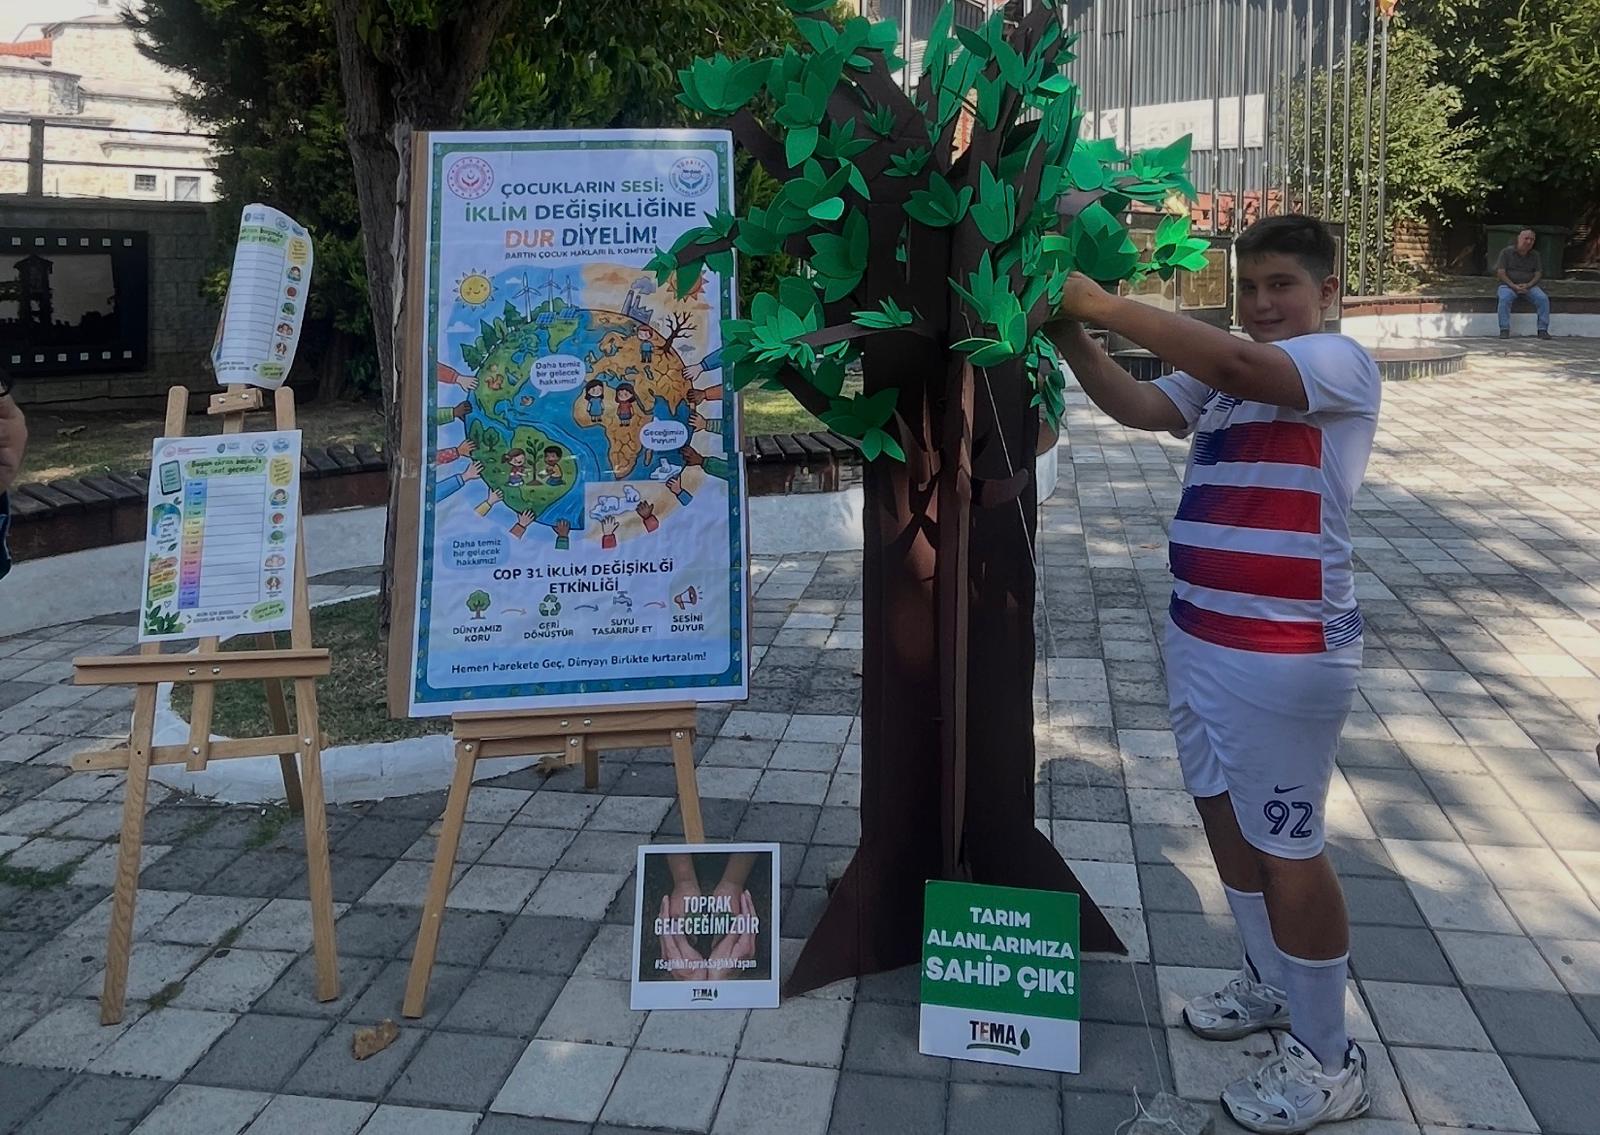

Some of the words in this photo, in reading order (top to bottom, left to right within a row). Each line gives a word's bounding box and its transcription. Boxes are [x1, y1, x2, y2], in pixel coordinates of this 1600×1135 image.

[501, 181, 615, 198] ÇOCUKLARIN
[621, 178, 664, 193] SESİ:
[465, 202, 527, 222] İKLİM
[535, 198, 697, 223] DEĞİŞİKLİĞİNE
[505, 229, 555, 249] DUR
[562, 222, 658, 247] DİYELİM!
[505, 251, 537, 260] BARTIN
[538, 250, 568, 259] ÇOCUK
[570, 248, 606, 257] HAKLARI
[617, 247, 657, 255] KOMİTES
[535, 361, 557, 370] Daha
[558, 360, 581, 369] temiz
[452, 540, 476, 549] Daha
[477, 539, 502, 547] temiz
[452, 549, 466, 558] bir
[493, 568, 522, 580] COP
[527, 567, 543, 579] 31
[547, 562, 588, 577] İKLİM
[549, 577, 619, 594] ETKİNLİĞİ
[538, 620, 560, 631] GERİ
[610, 618, 635, 627] SUYU
[672, 613, 704, 624] SESİNİ
[452, 624, 503, 636] DÜNYAMIZI
[523, 628, 575, 640] DÖNÜŞTÜR
[591, 625, 640, 636] TASARRUF
[641, 625, 654, 634] ET
[670, 624, 705, 633] DUYUR
[464, 634, 491, 643] KORU
[451, 664, 489, 675] Hemen
[611, 655, 650, 666] Birlikte
[1263, 799, 1314, 839] 92
[683, 895, 732, 914] TOPRAK
[654, 913, 760, 936] GELECEĞİMİZDİR
[969, 906, 1031, 929] TARIM
[926, 928, 1075, 960] ALANLARIMIZA
[926, 955, 1012, 987] SAHİP
[1016, 966, 1076, 999] ÇIK!
[692, 987, 713, 999] TEMA
[969, 1020, 1017, 1046] TEMA
